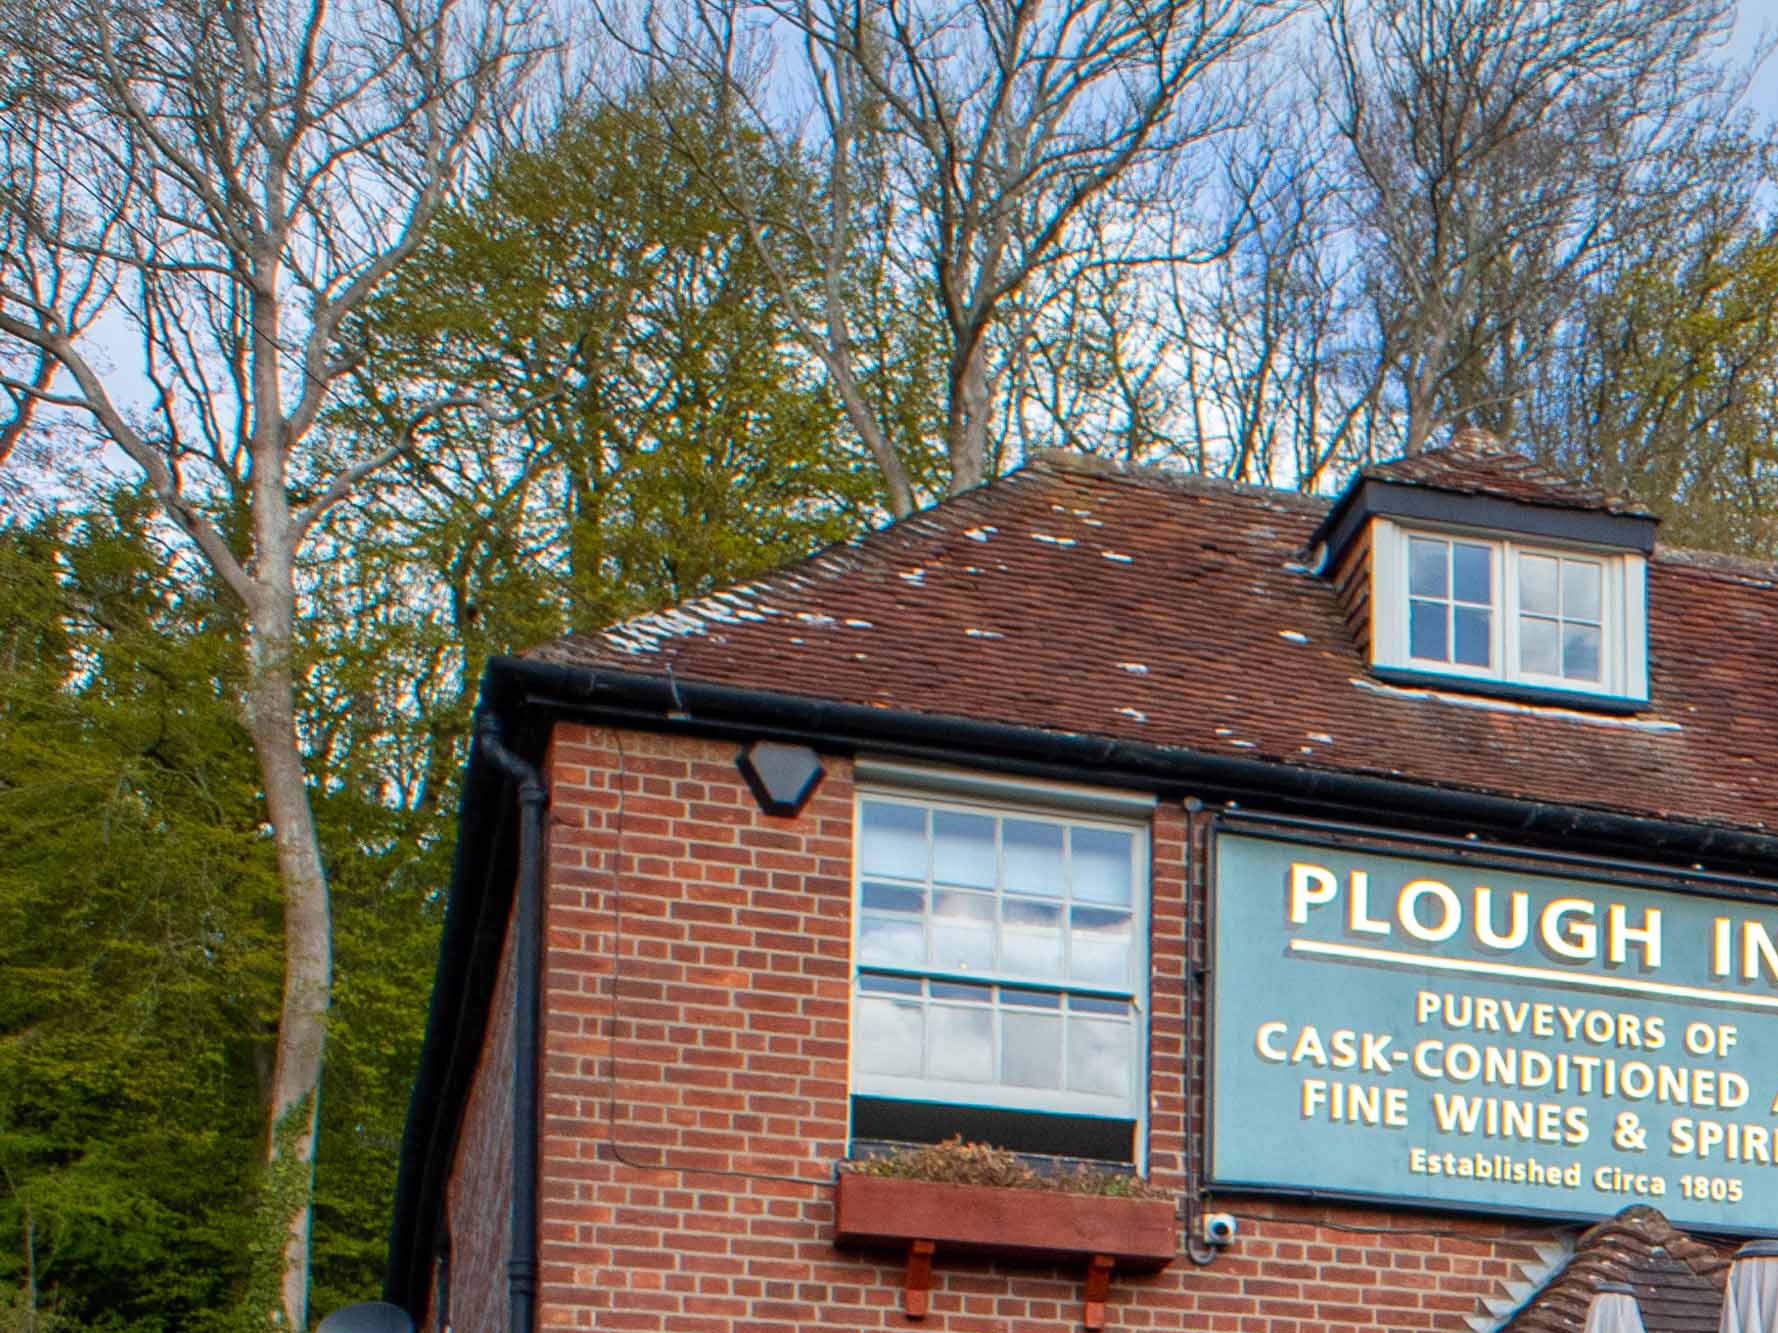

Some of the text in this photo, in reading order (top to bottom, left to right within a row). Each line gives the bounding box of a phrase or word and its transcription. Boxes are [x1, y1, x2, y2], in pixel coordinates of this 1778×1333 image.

[1288, 862, 1664, 970] PLOUGH
[1416, 990, 1739, 1058] PURVEYORS OF
[1256, 1021, 1750, 1110] CASK-CONDITIONED
[1302, 1077, 1410, 1128] FINE
[1435, 1092, 1591, 1146] WINES
[1614, 1112, 1648, 1152] &
[1409, 1147, 1743, 1203] Established Circa 1805
